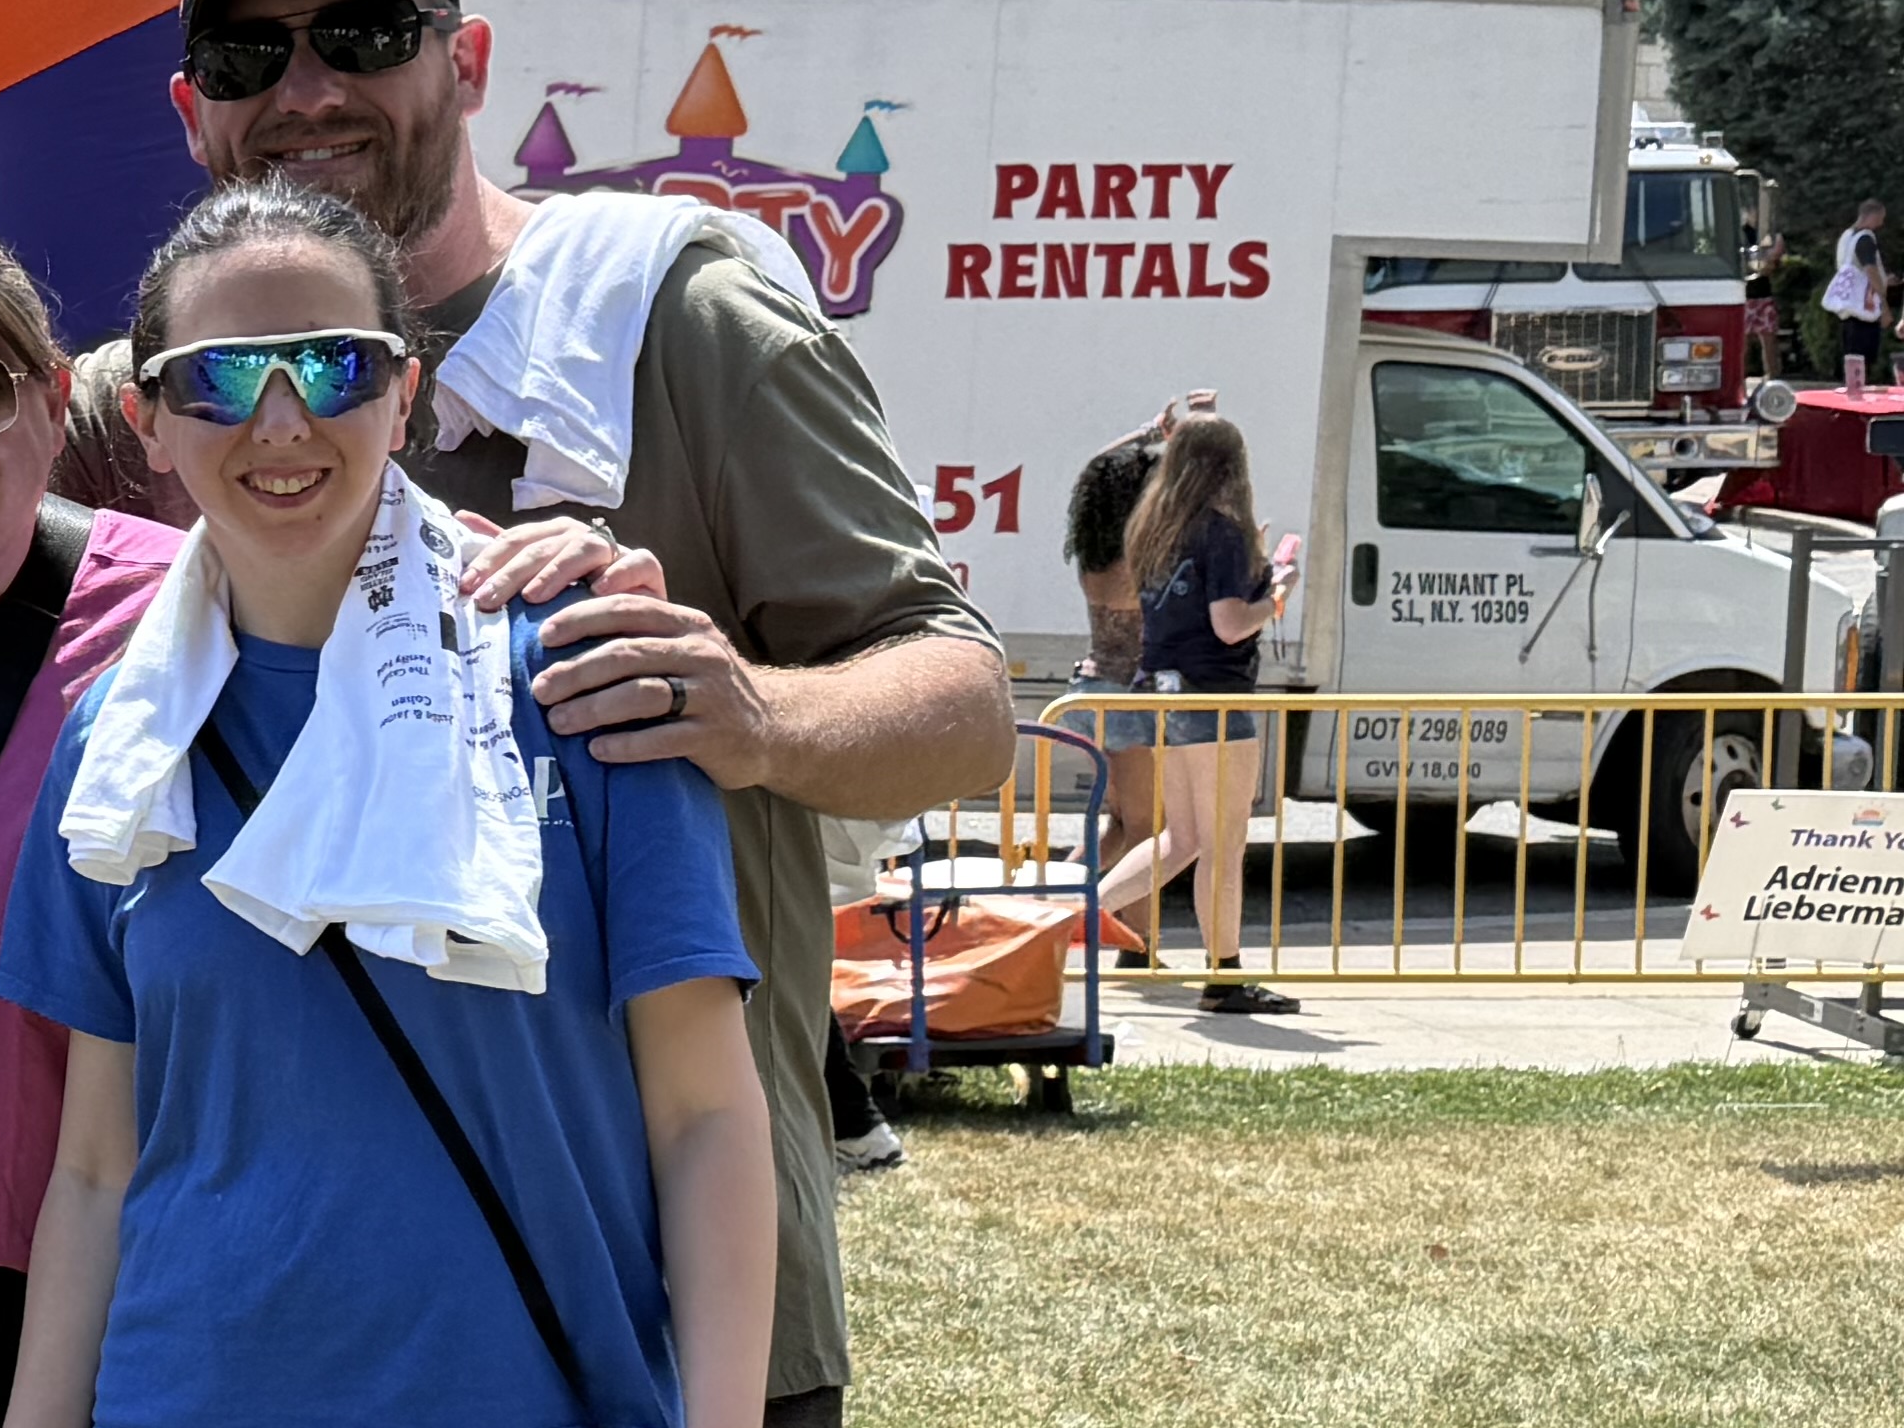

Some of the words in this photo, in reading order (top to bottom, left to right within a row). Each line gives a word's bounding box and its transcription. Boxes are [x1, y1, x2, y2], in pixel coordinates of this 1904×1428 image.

[992, 162, 1234, 220] PARTY
[945, 240, 1270, 300] RENTALS
[1391, 572, 1412, 595] 24
[1418, 573, 1500, 597] WINANT
[1431, 601, 1464, 623] N.Y.
[1471, 601, 1529, 623] 10309
[1420, 718, 1508, 743] 298089
[1422, 762, 1482, 780] 18,00
[1790, 828, 1876, 850] Thank
[1764, 864, 1904, 896] Adrienn
[1743, 895, 1904, 926] Lieberma
